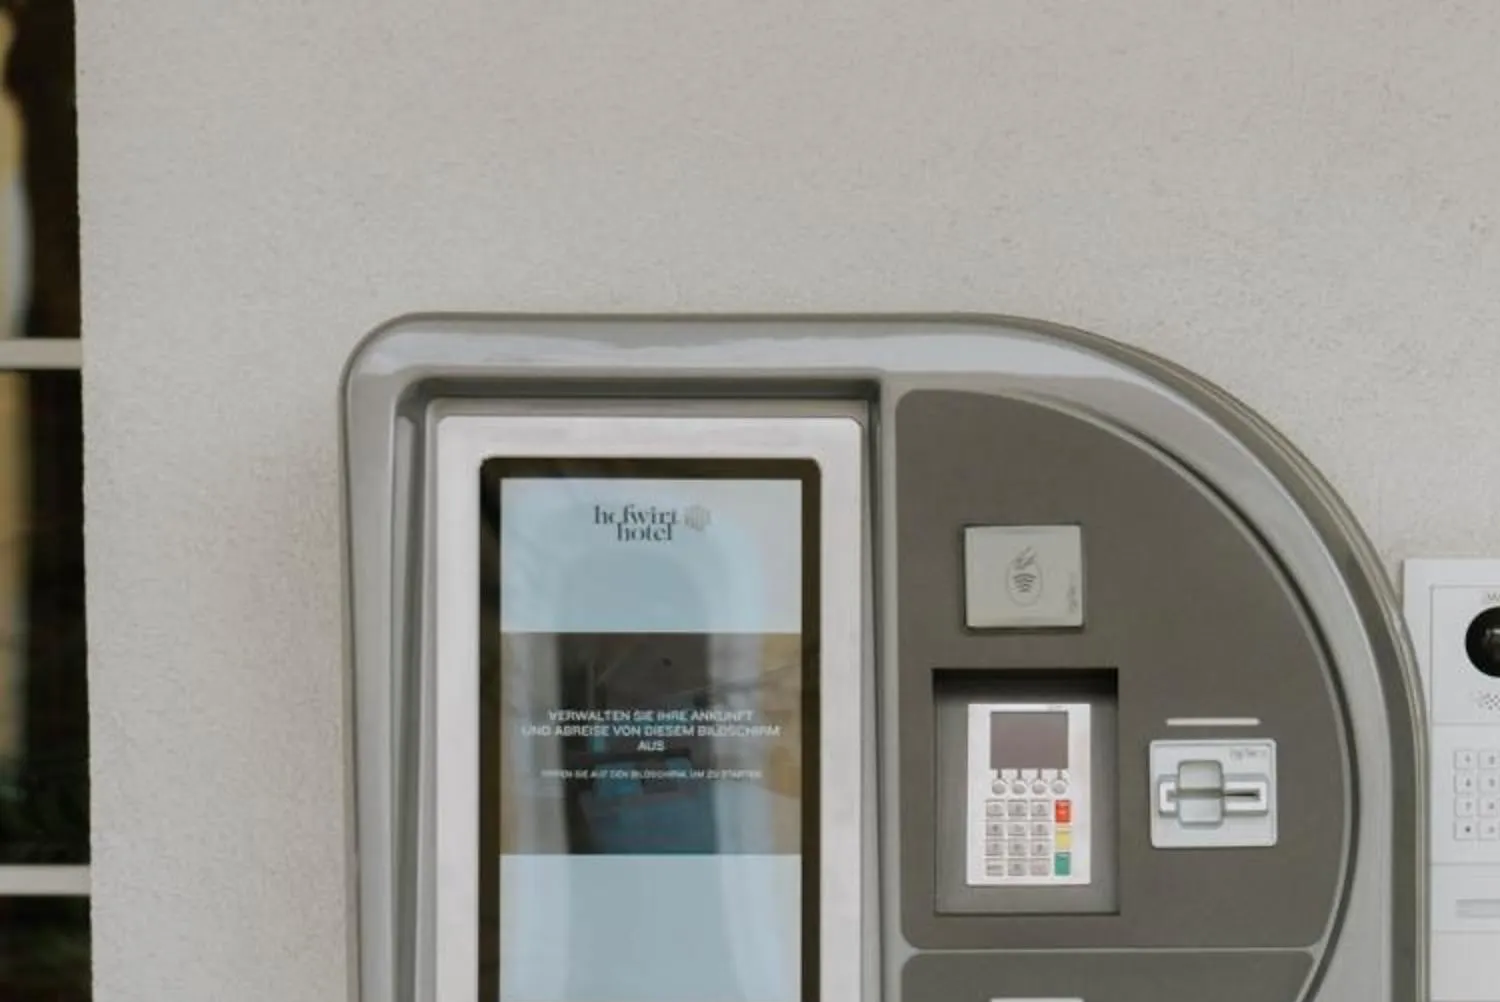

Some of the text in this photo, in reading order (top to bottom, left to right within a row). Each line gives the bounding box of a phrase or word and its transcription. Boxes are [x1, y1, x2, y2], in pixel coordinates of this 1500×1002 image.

[616, 521, 672, 541] hotel
[547, 709, 754, 721] VERWALTEN SIE IHRE ANKUNFT
[521, 725, 780, 737] UND ABREISE VON DIESEM BILDSCHIRM
[637, 740, 665, 751] AUS
